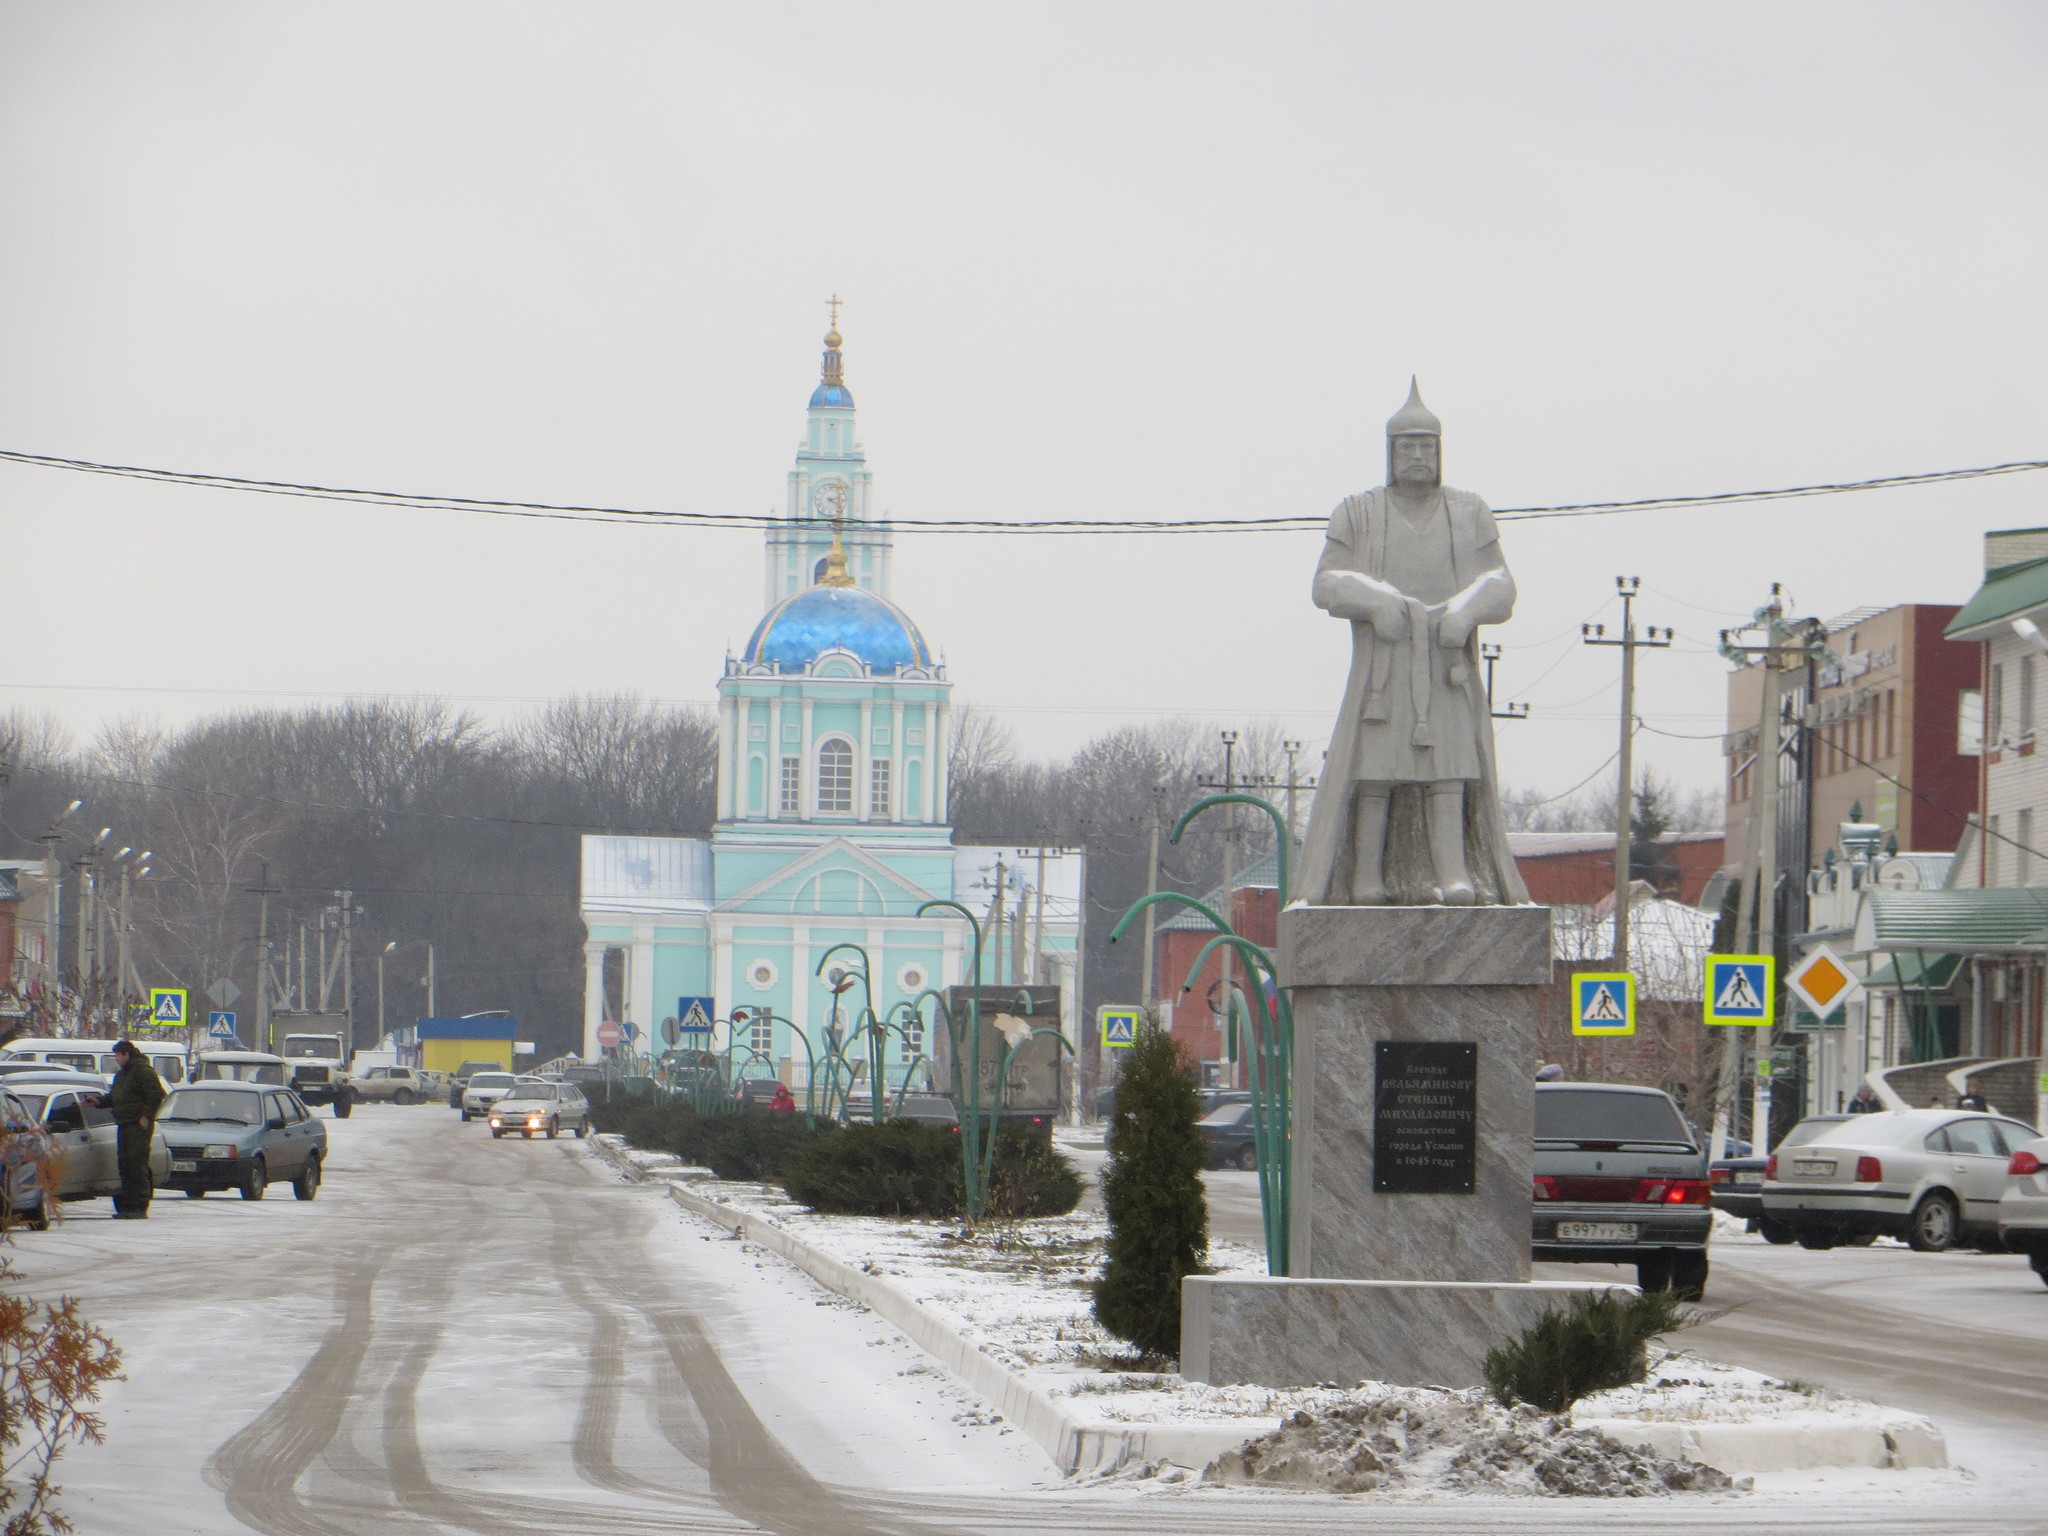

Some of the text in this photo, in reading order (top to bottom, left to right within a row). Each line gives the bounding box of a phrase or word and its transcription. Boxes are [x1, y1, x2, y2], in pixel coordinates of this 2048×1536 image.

[1381, 1079, 1474, 1092] ВЕЛЬЯМИНОВУ
[1397, 1094, 1456, 1107] СТЕПАНУ
[1379, 1108, 1474, 1122] МИХАЙЛОВИЧУ
[1396, 1127, 1456, 1135] основателю
[1389, 1140, 1464, 1151] города Усмани
[1405, 1156, 1430, 1166] 1645
[1432, 1158, 1456, 1168] году
